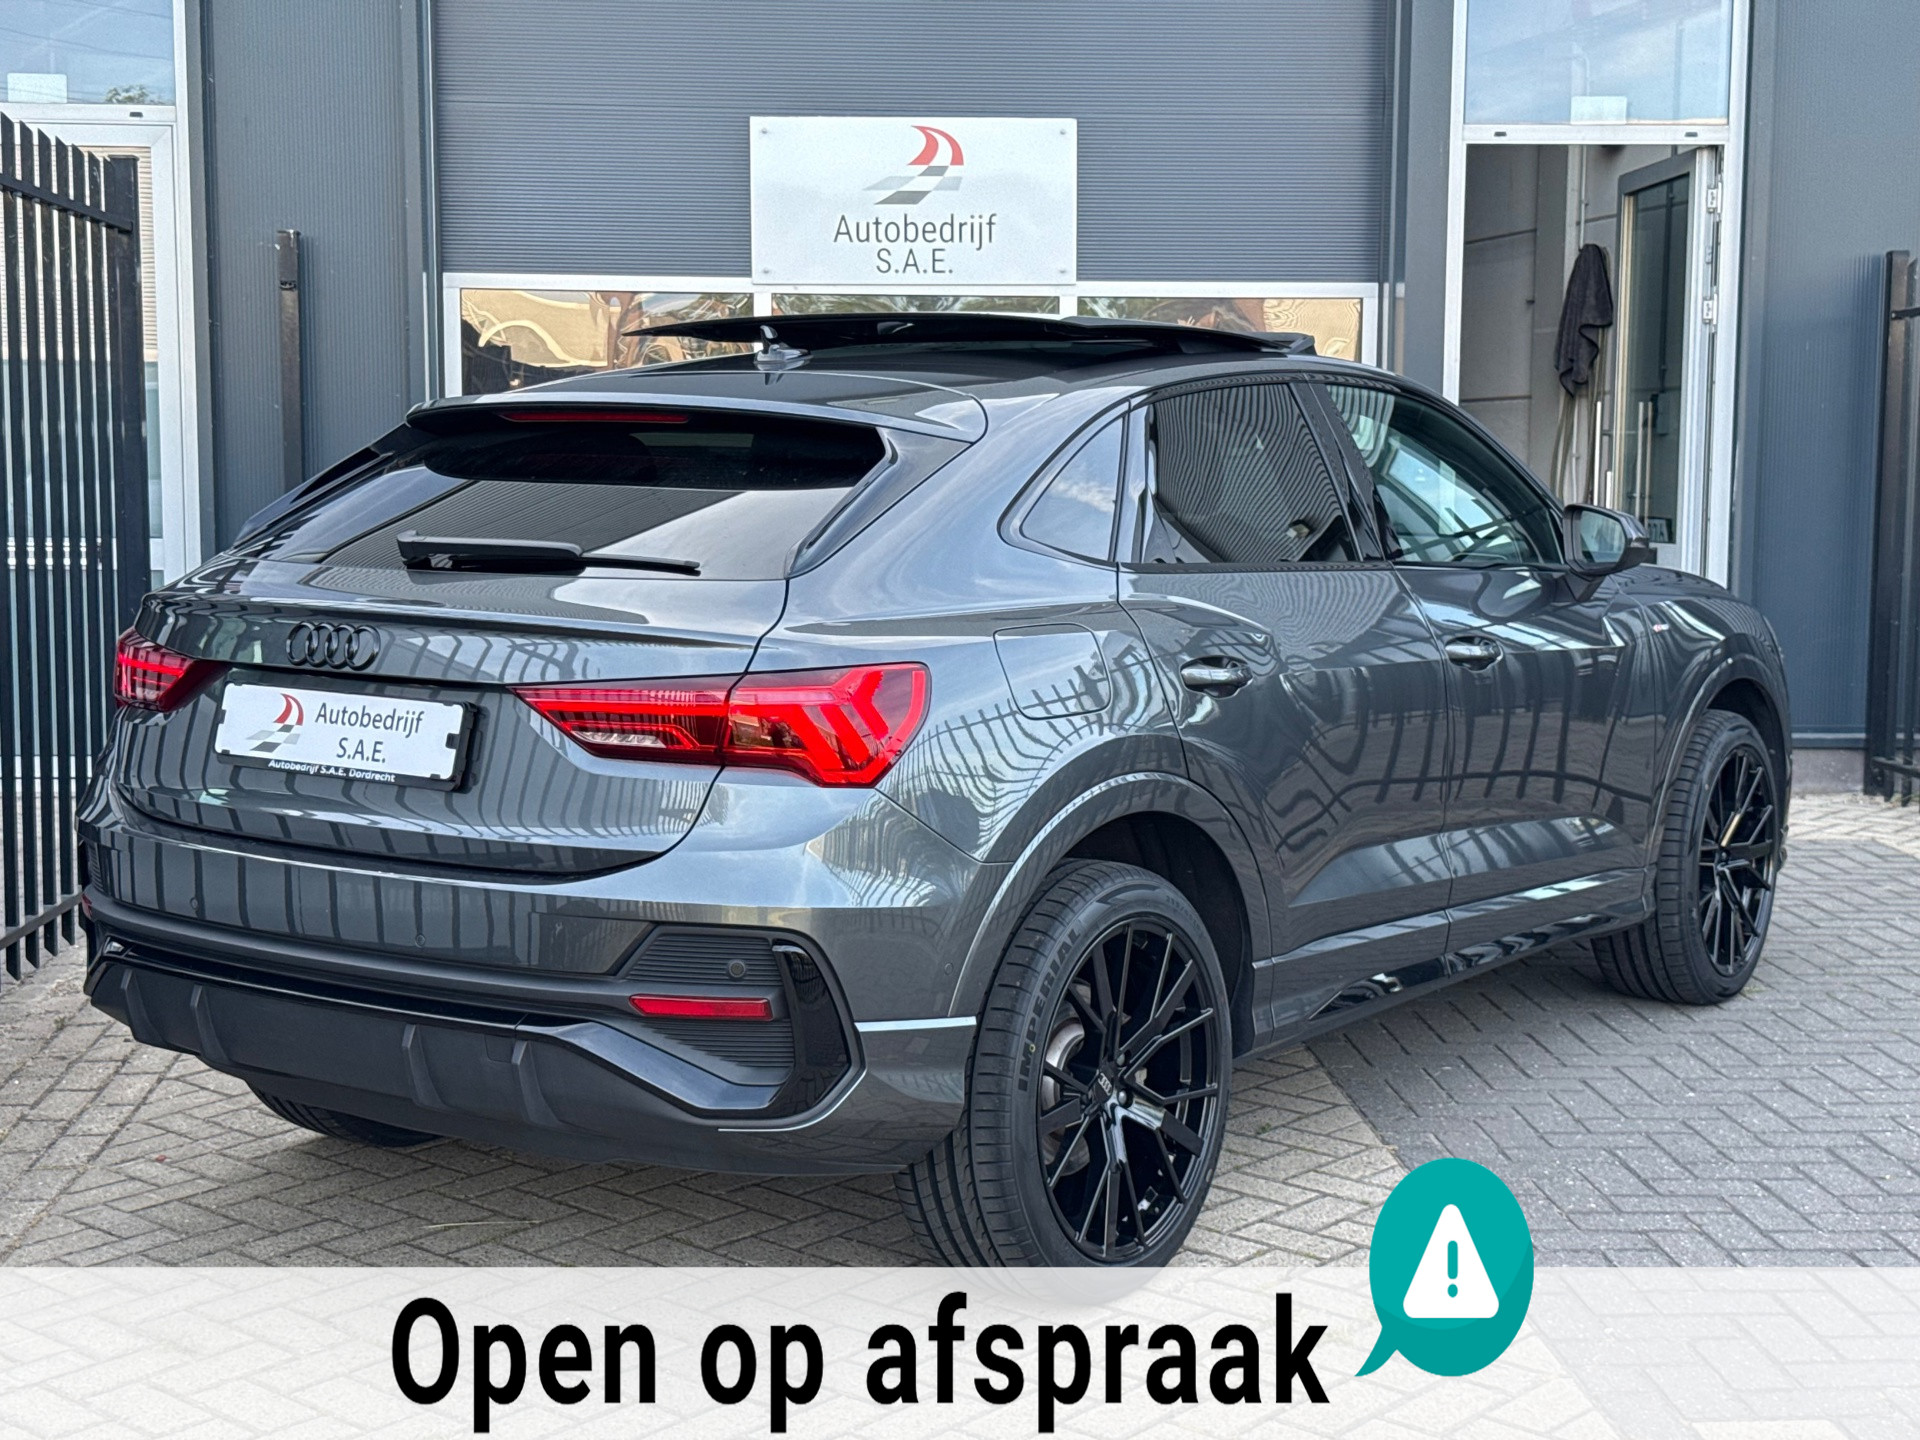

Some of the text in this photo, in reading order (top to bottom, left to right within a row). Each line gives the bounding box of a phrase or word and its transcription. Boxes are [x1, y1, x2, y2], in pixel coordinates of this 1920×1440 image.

[833, 213, 997, 250] Autobedrijf
[876, 248, 953, 274] S.A.E.
[315, 702, 425, 738] Autobedrijf
[336, 737, 387, 764] S.A.E.
[268, 759, 396, 783] Autobedrijf S.A.E. Dordrecht
